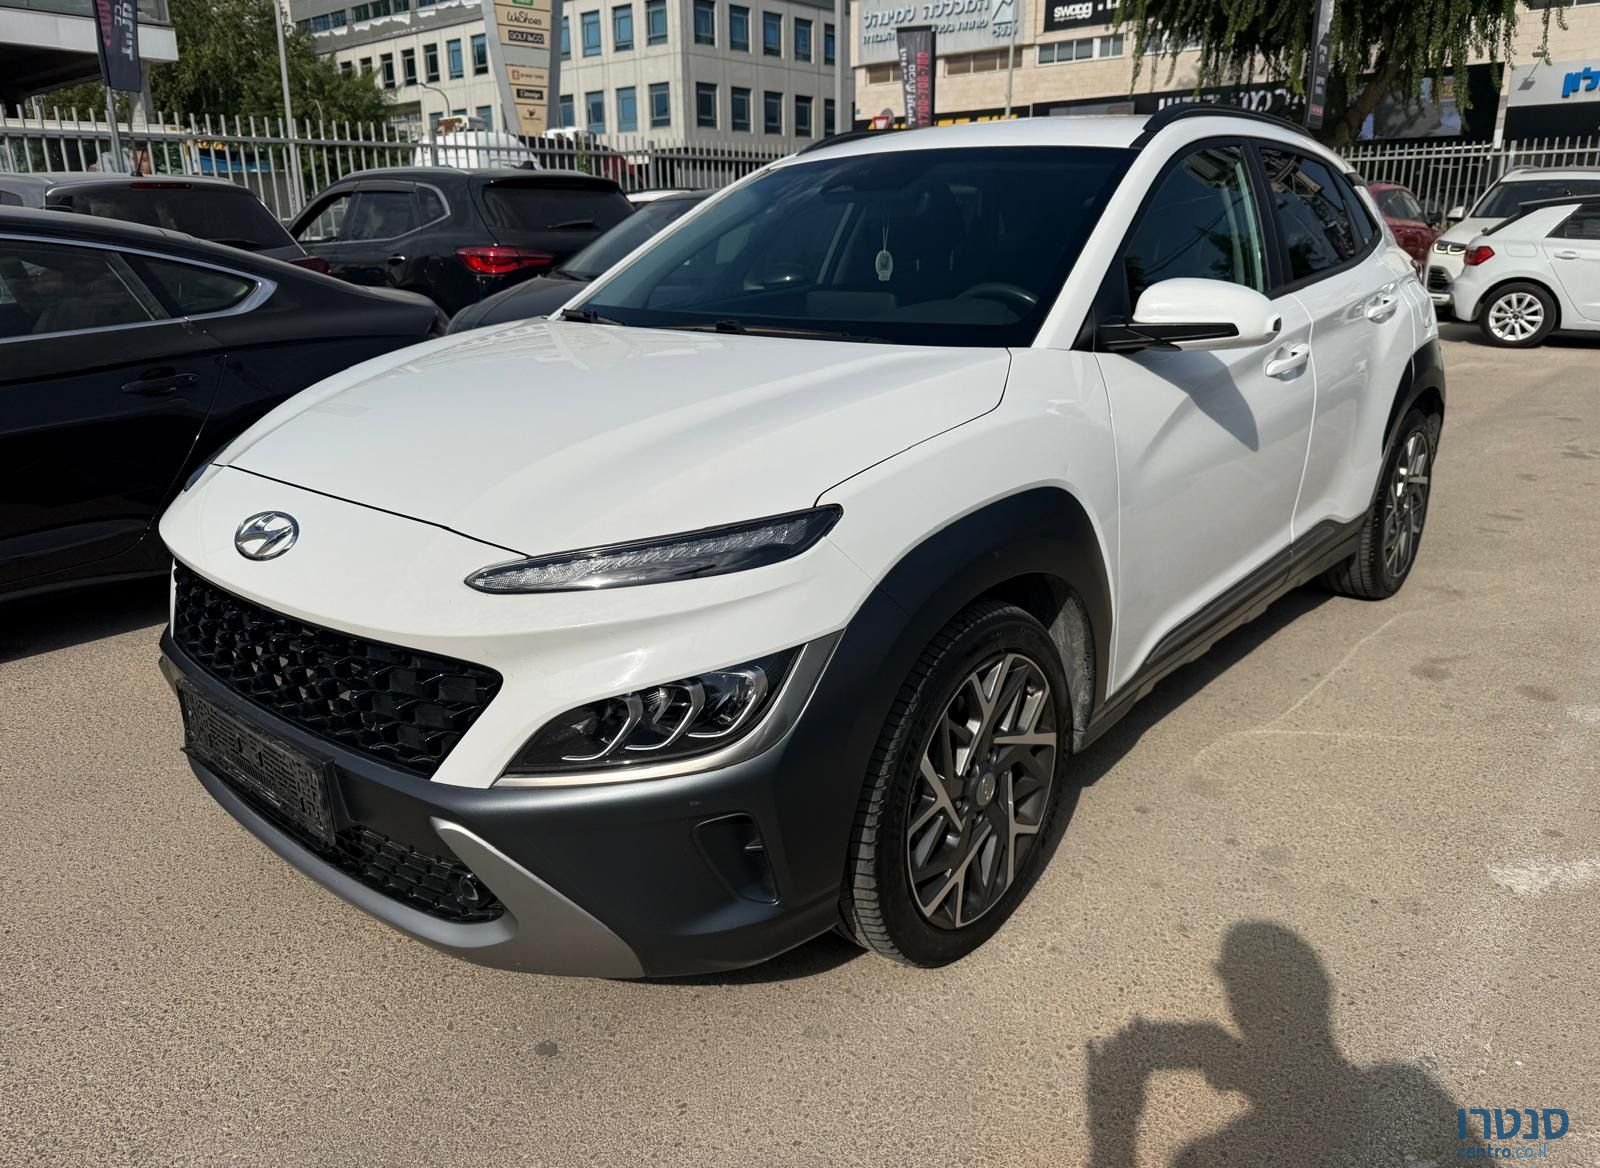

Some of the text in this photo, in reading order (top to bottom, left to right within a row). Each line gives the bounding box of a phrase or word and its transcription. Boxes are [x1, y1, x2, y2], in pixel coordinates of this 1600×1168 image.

[506, 10, 542, 25] WeShoes
[864, 4, 917, 29] למינהל
[922, 0, 991, 20] המכללה
[1053, 1, 1093, 20] swagg
